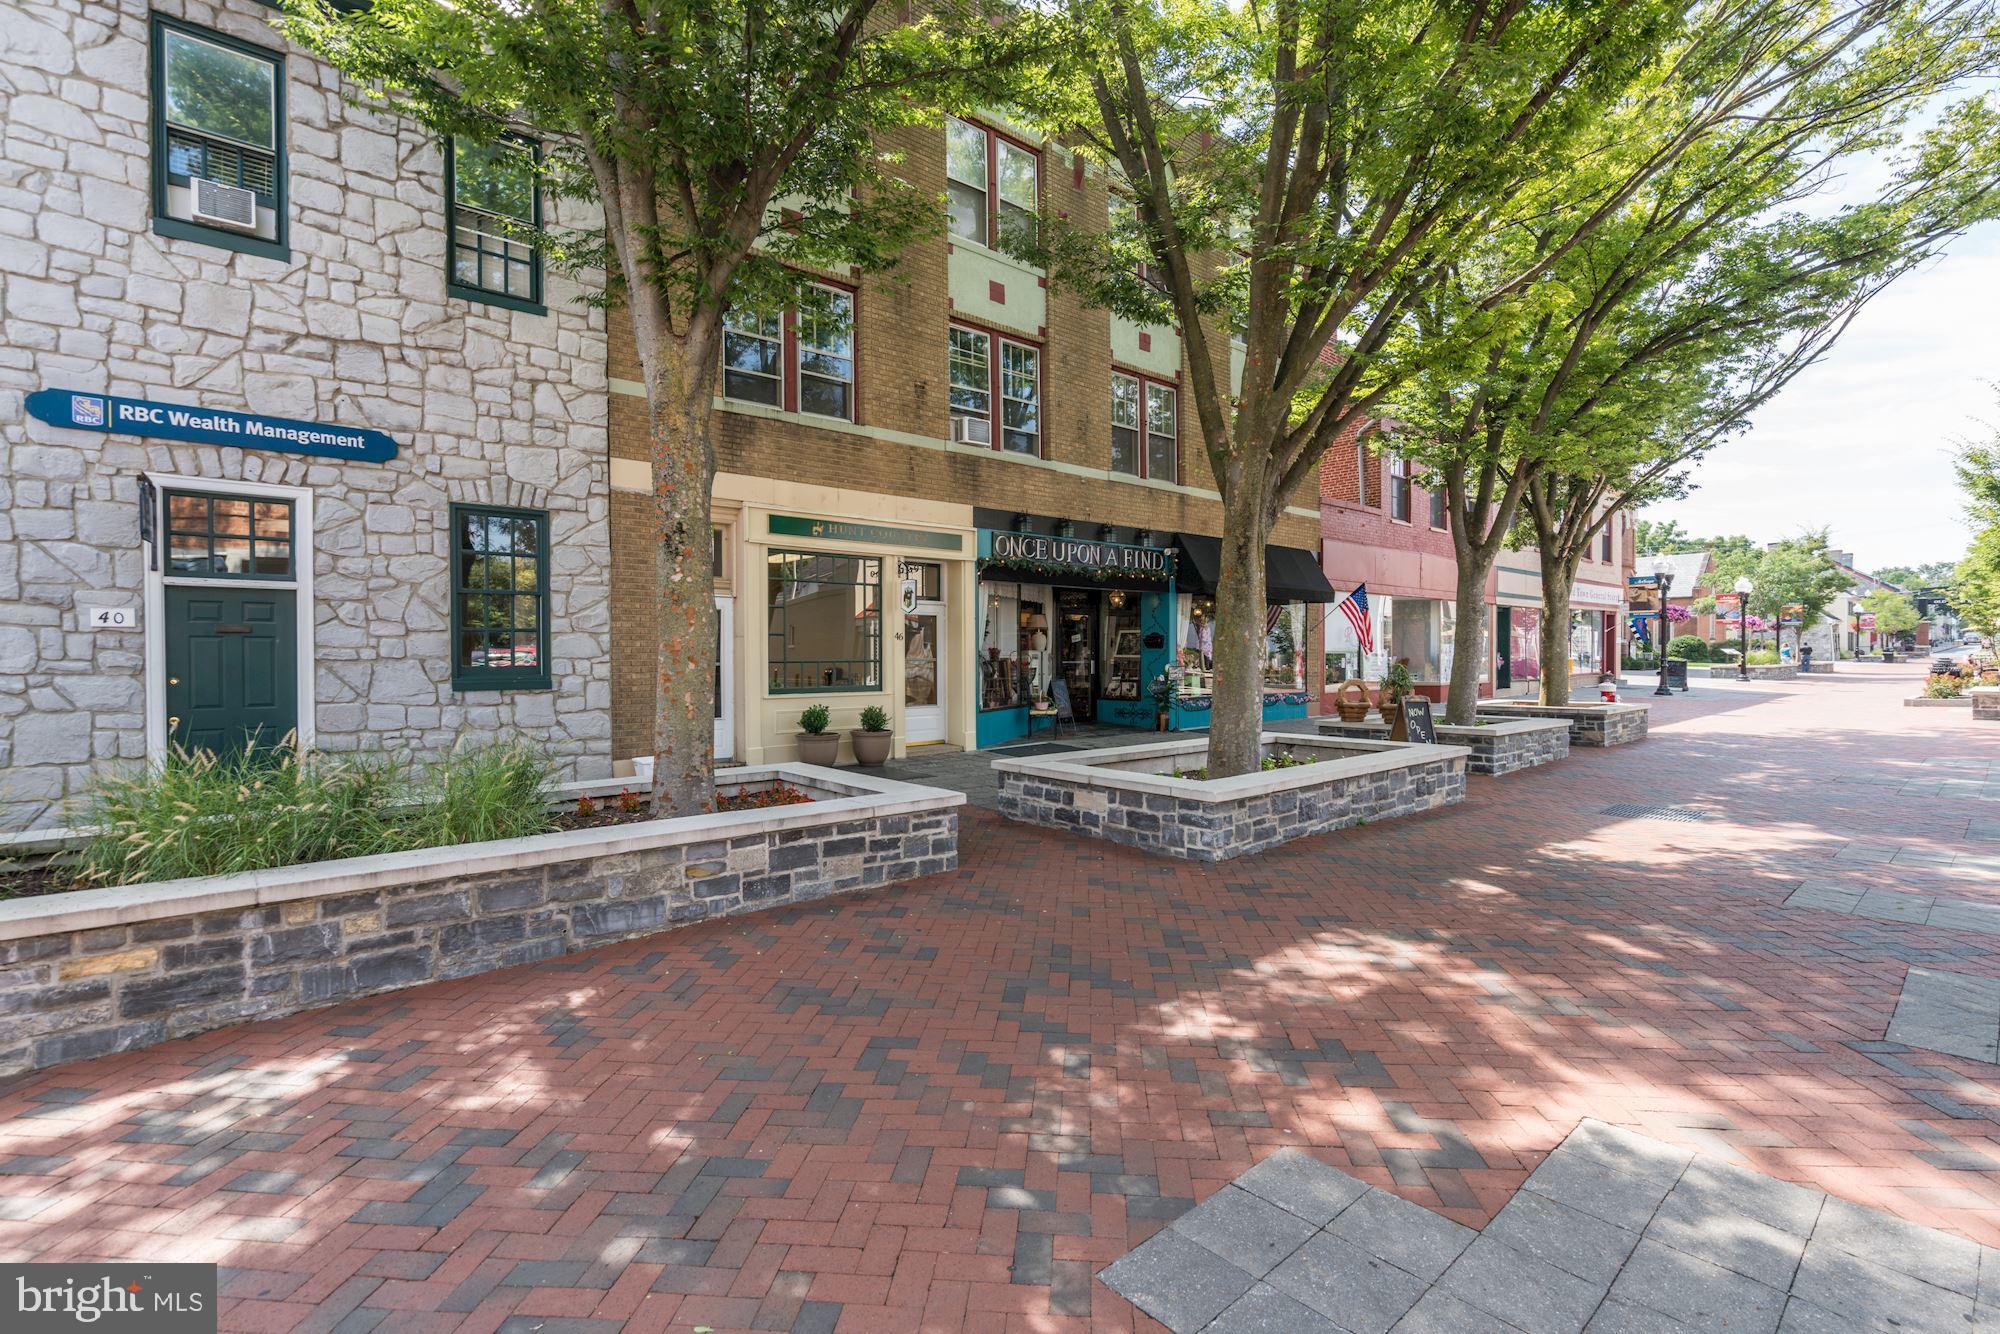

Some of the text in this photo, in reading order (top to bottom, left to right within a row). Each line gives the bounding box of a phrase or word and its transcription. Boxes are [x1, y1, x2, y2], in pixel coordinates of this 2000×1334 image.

[76, 414, 100, 424] RBC
[119, 404, 365, 449] RBC Wealth Management
[995, 534, 1164, 570] ONCE UPON A FIND
[98, 611, 124, 624] 40
[894, 632, 904, 641] 46
[1408, 707, 1424, 717] NOW
